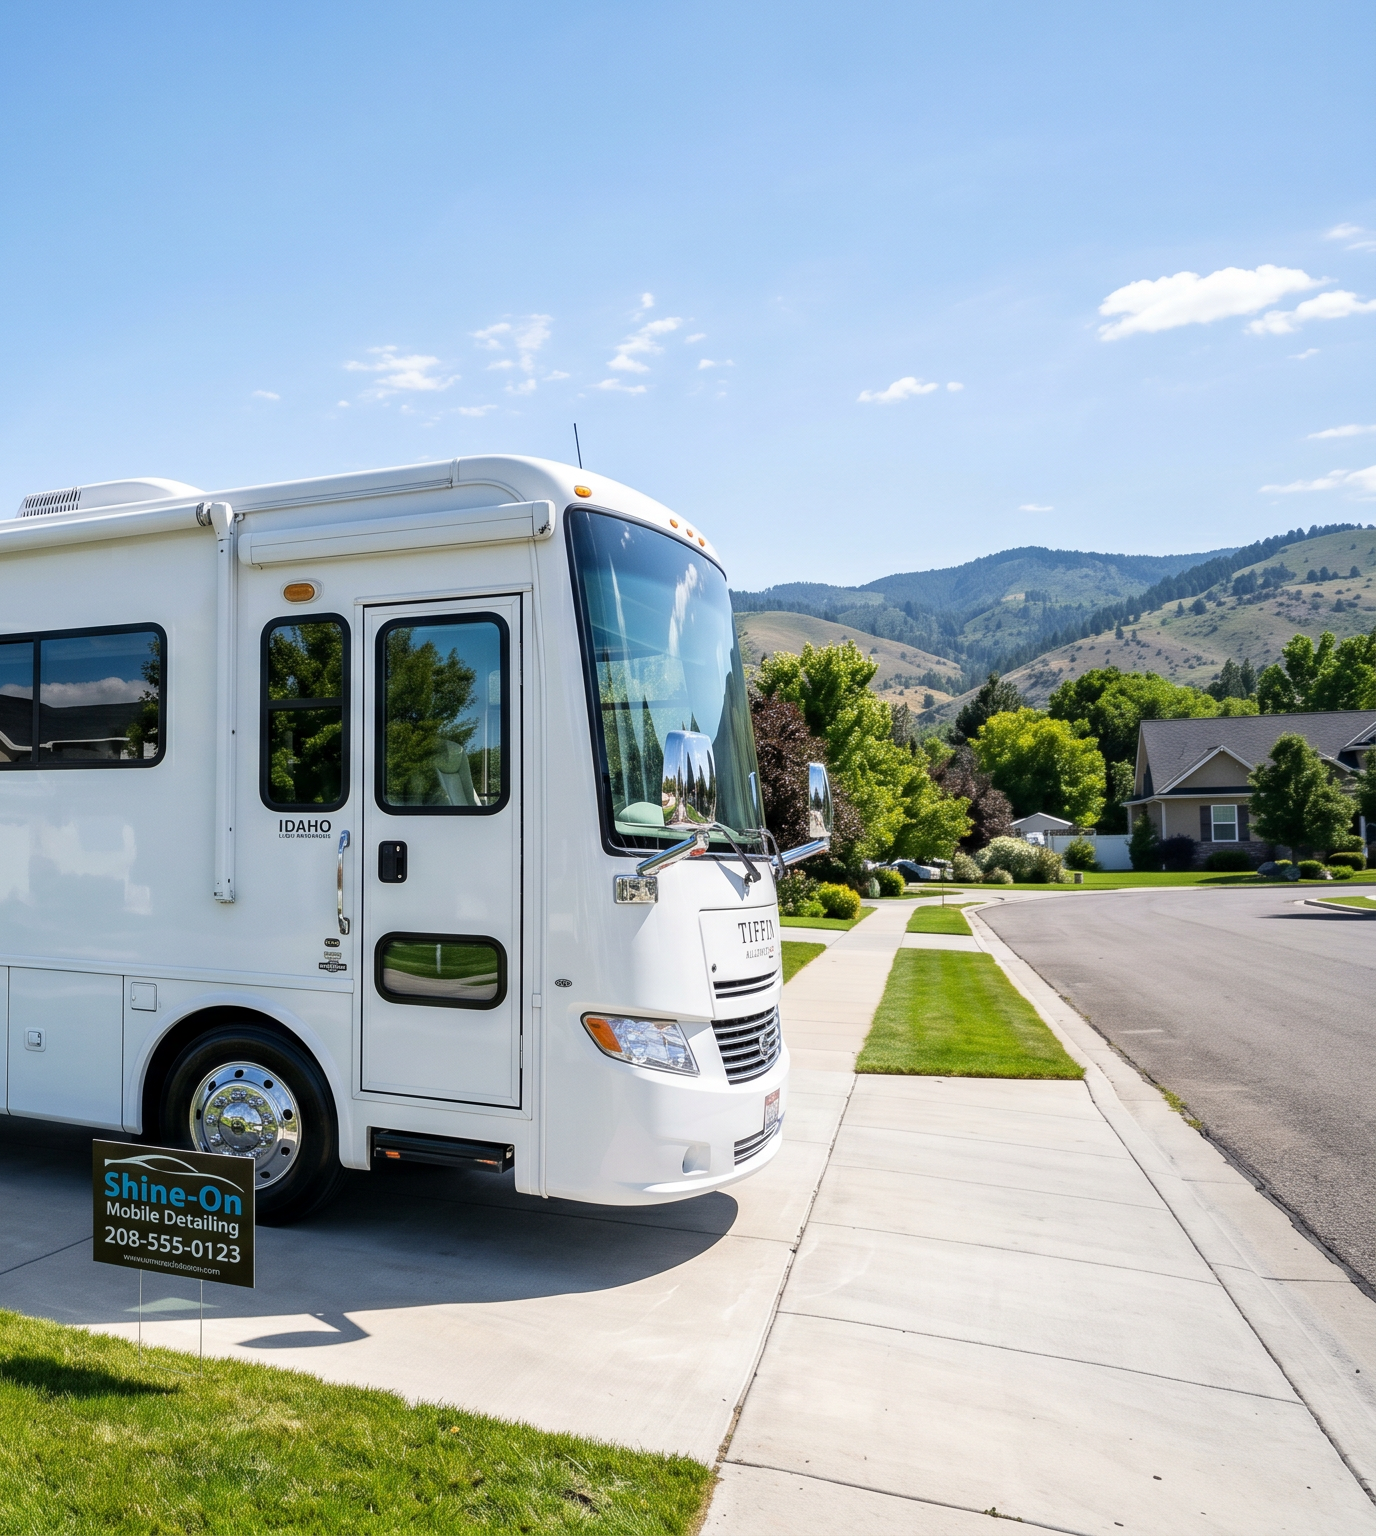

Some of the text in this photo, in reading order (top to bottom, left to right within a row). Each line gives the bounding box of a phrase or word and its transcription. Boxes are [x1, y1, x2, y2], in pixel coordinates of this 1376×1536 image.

[279, 819, 332, 833] IDAHO
[737, 919, 775, 944] TIFFIN
[104, 1171, 242, 1216] Shine-On
[106, 1201, 240, 1239] Mobile Detailing
[104, 1225, 241, 1264] 208-555-0123
